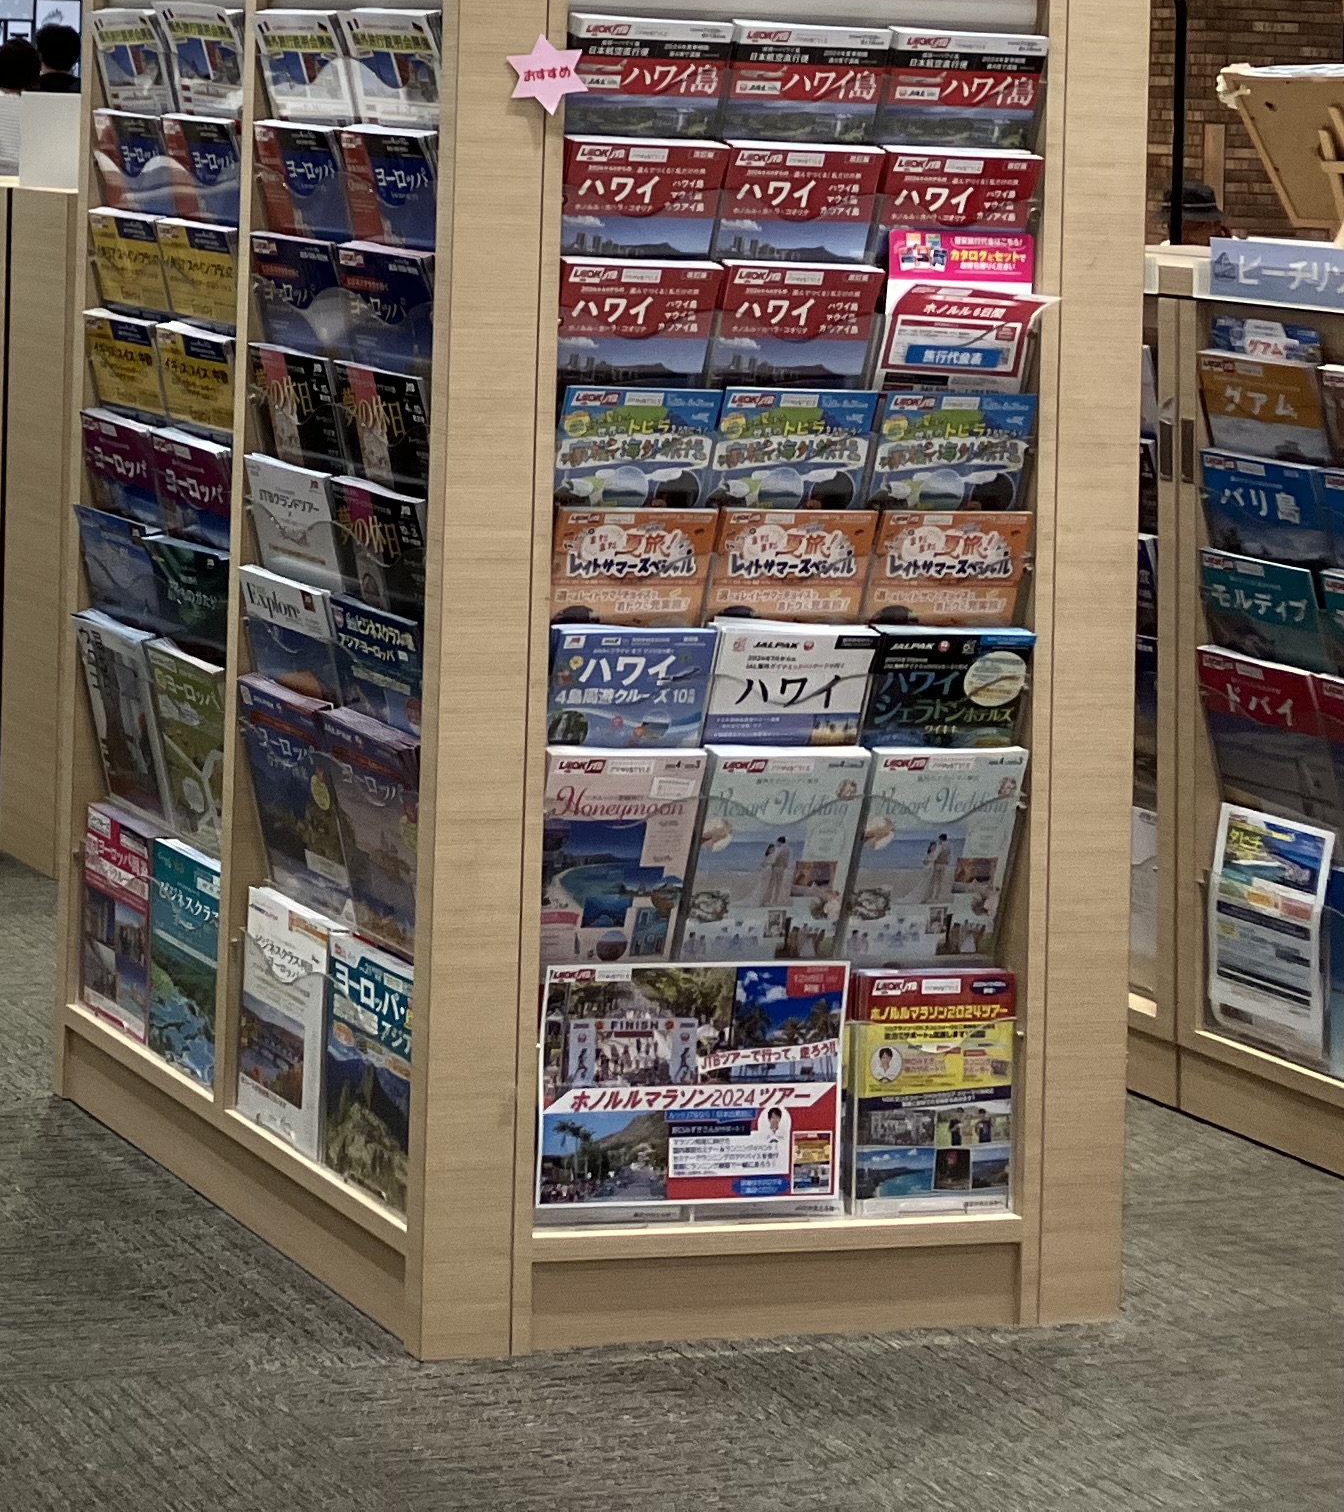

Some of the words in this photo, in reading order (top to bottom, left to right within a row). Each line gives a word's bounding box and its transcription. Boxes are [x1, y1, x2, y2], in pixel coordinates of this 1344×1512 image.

[523, 66, 572, 82] おすすめ
[622, 63, 719, 96] ハワイ島
[782, 70, 877, 102] ハワイ島
[940, 76, 1035, 107] ハワイ島
[577, 175, 661, 205] ハワイ
[737, 179, 818, 208] ハワイ
[893, 185, 975, 214] ハワイ
[571, 296, 655, 326] ハワイ
[734, 298, 816, 328] ハワイ
[577, 654, 678, 686] ハワイ
[735, 674, 842, 709] ハワイ
[611, 1020, 660, 1030] FINISH
